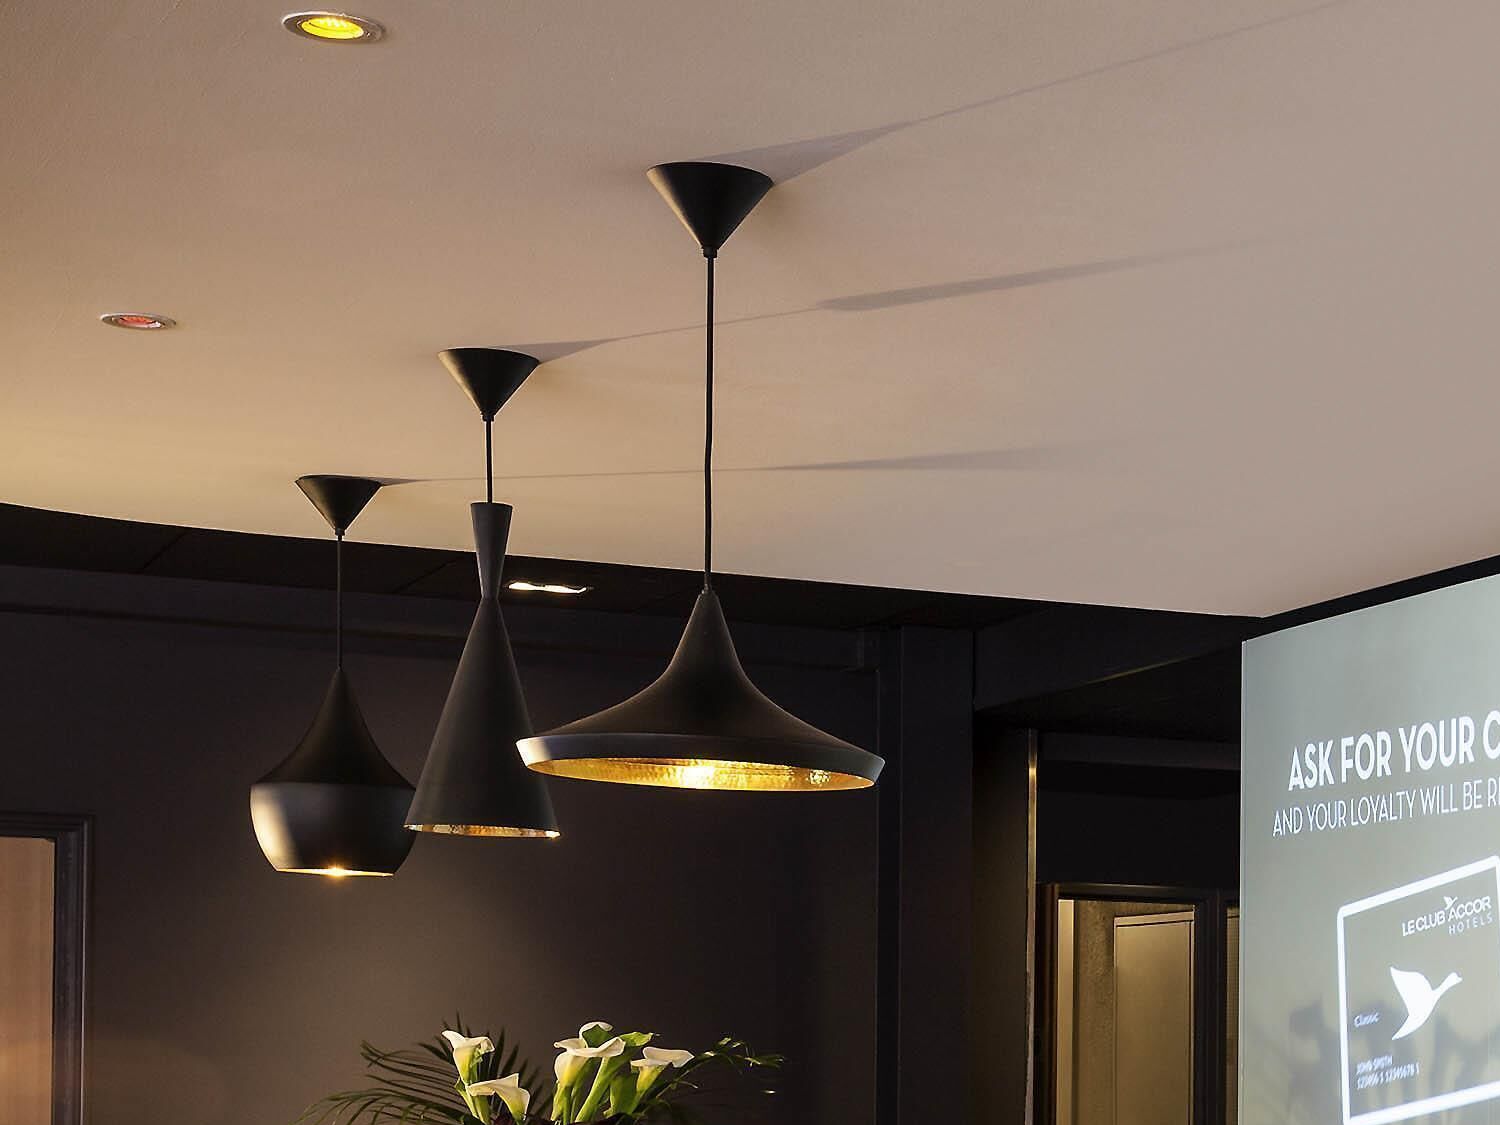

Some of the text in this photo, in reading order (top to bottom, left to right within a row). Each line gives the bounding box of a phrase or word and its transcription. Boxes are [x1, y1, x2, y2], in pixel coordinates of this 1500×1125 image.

[1287, 738, 1335, 792] ASK
[1340, 730, 1392, 783] FOR
[1398, 716, 1475, 772] YOUR
[1272, 807, 1303, 837] AND
[1306, 800, 1347, 831] YOUR
[1350, 789, 1417, 826] LOYALTY
[1420, 783, 1458, 815] WILL
[1463, 780, 1483, 810] BE
[1447, 896, 1492, 922] ACCOR
[1449, 913, 1493, 935] HOTELS
